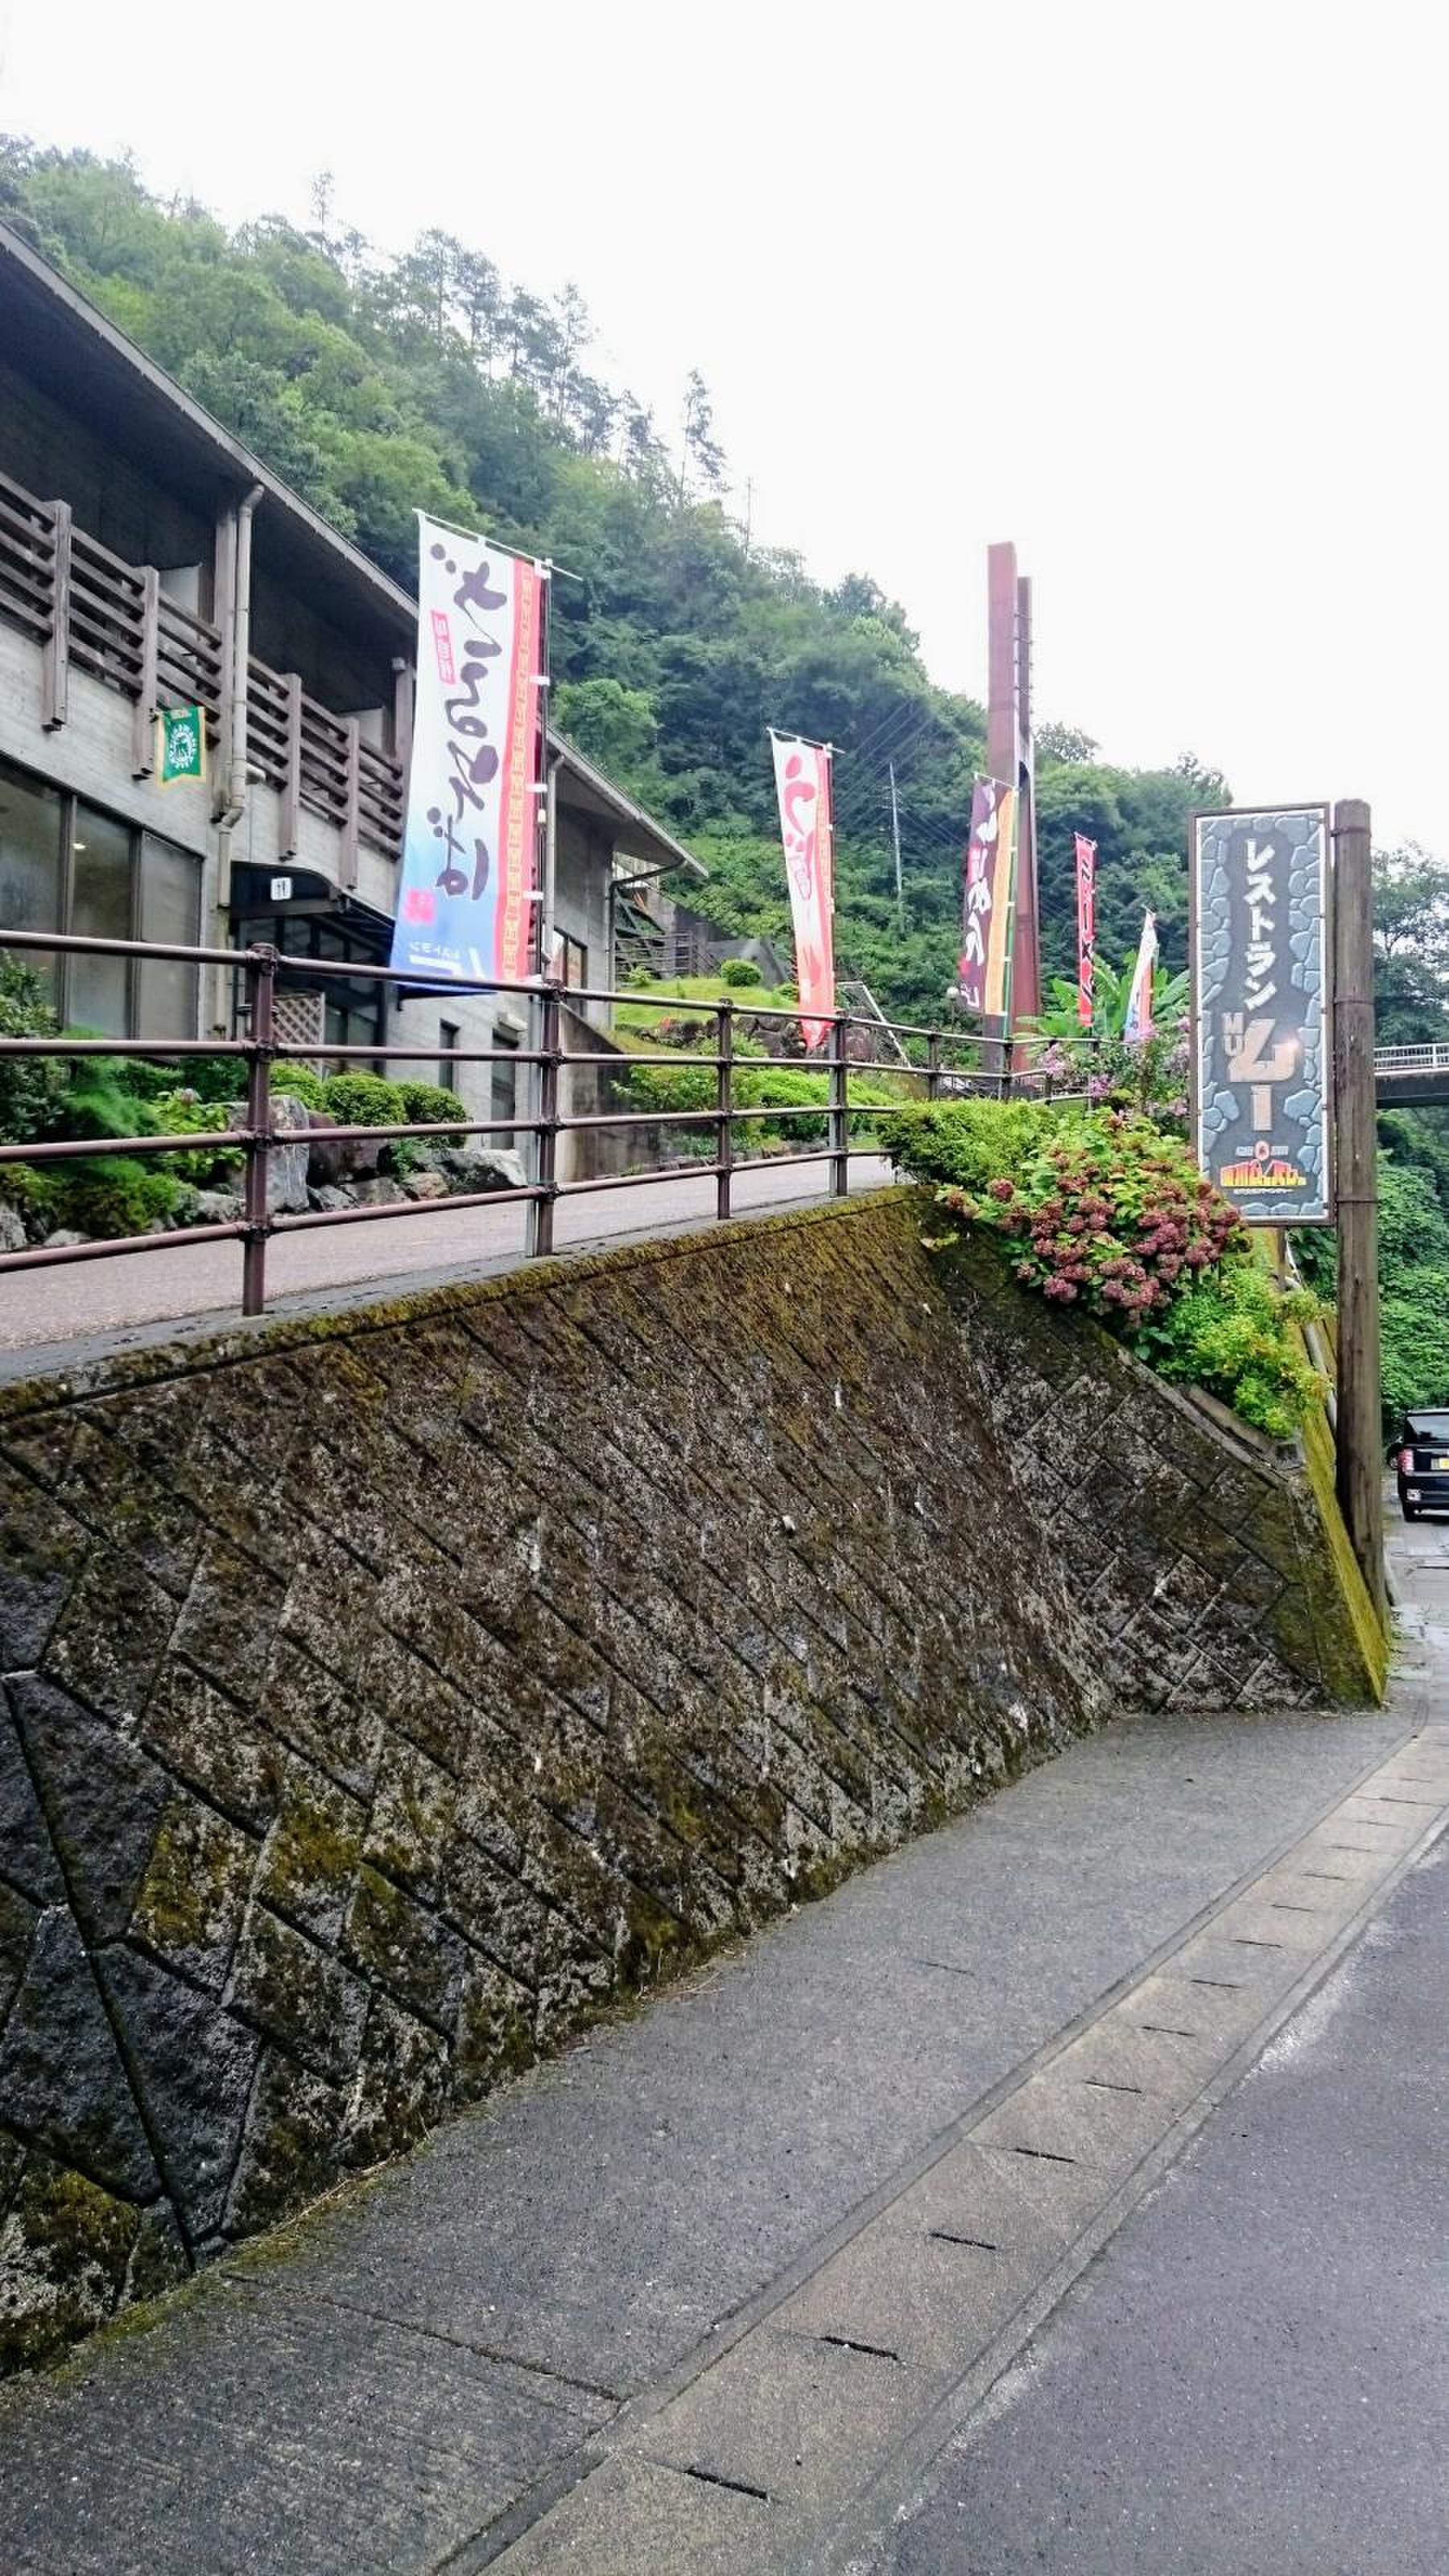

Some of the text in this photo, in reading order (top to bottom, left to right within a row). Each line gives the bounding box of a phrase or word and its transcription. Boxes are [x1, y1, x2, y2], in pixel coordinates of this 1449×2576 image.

[1245, 838, 1277, 1011] レストラン
[1229, 1018, 1300, 1131] ムー
